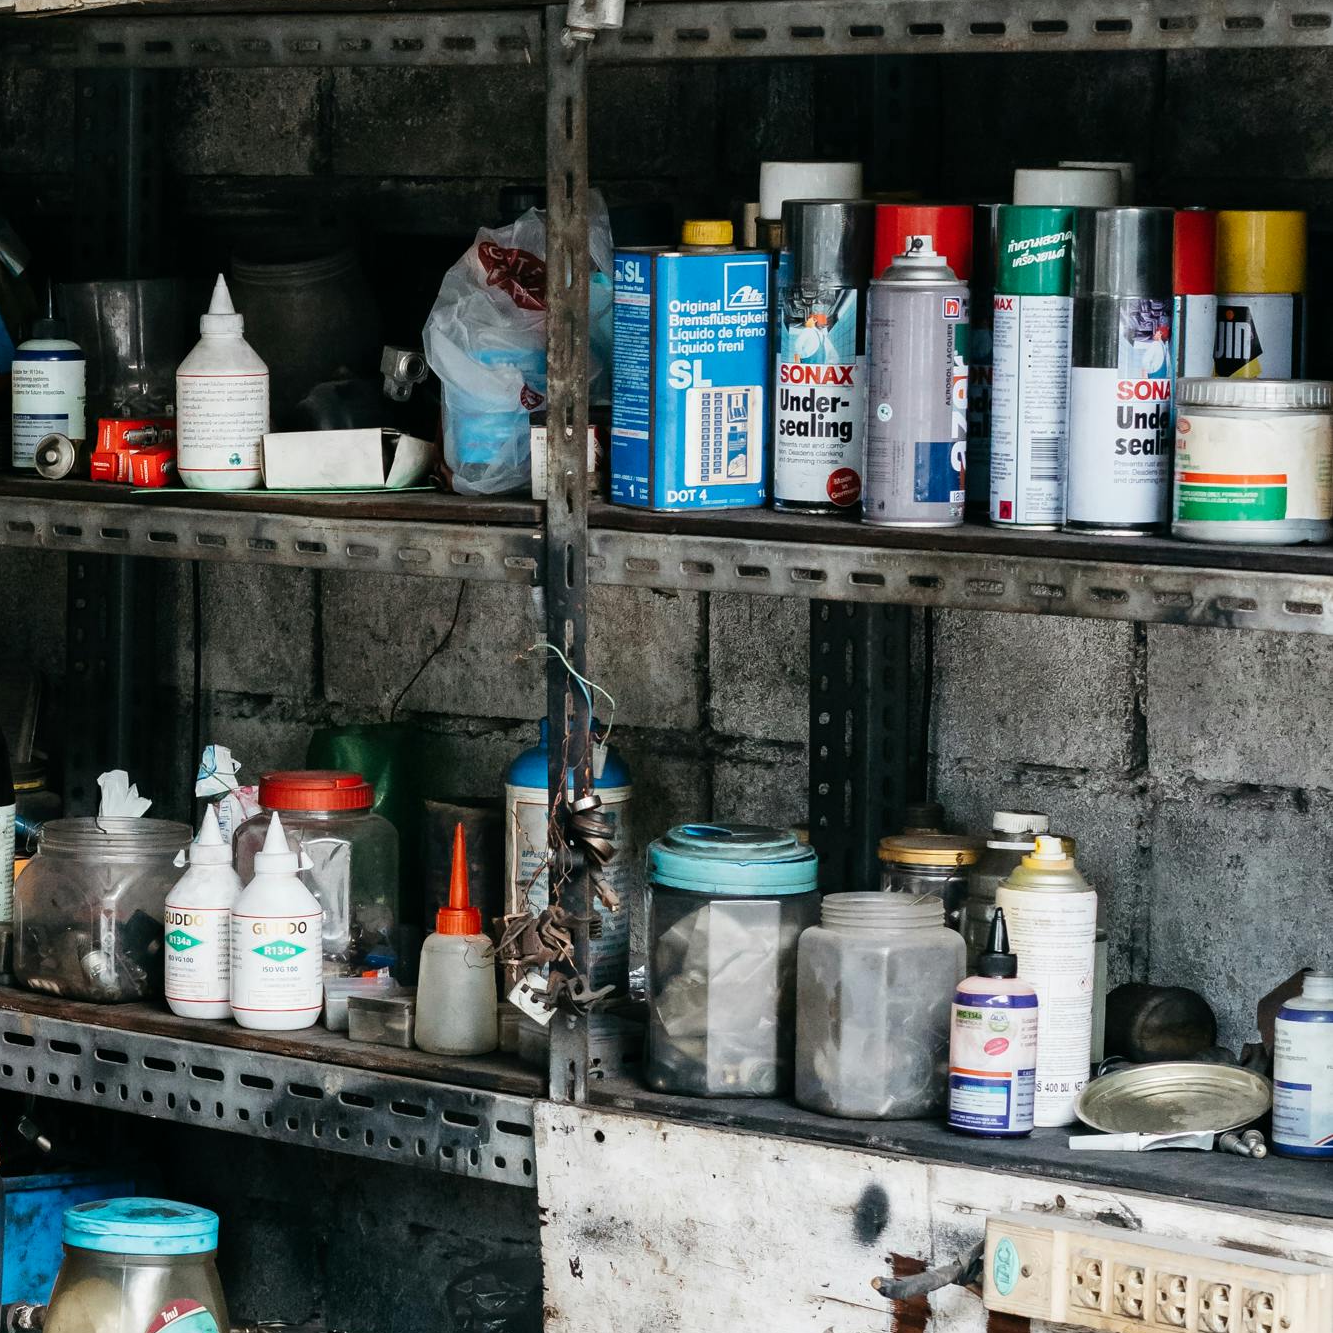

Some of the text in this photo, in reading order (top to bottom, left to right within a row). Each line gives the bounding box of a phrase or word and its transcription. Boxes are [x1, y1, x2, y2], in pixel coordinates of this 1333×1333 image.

[623, 260, 645, 285] SL
[669, 299, 721, 314] Original
[669, 310, 769, 328] Bremsflüssigkeit
[717, 326, 733, 338] de
[735, 324, 766, 337] freno
[717, 339, 744, 353] freni
[946, 322, 954, 365] LACQUER
[668, 358, 713, 390] SL
[779, 364, 854, 386] SONAX
[779, 387, 850, 414] Under-
[779, 413, 853, 444] sealing
[815, 448, 844, 459] clanking
[666, 488, 708, 504] DOT 4
[168, 934, 192, 947] R134a
[264, 945, 296, 956] R134a
[182, 956, 194, 964] 100
[1044, 1082, 1059, 1093] 400
